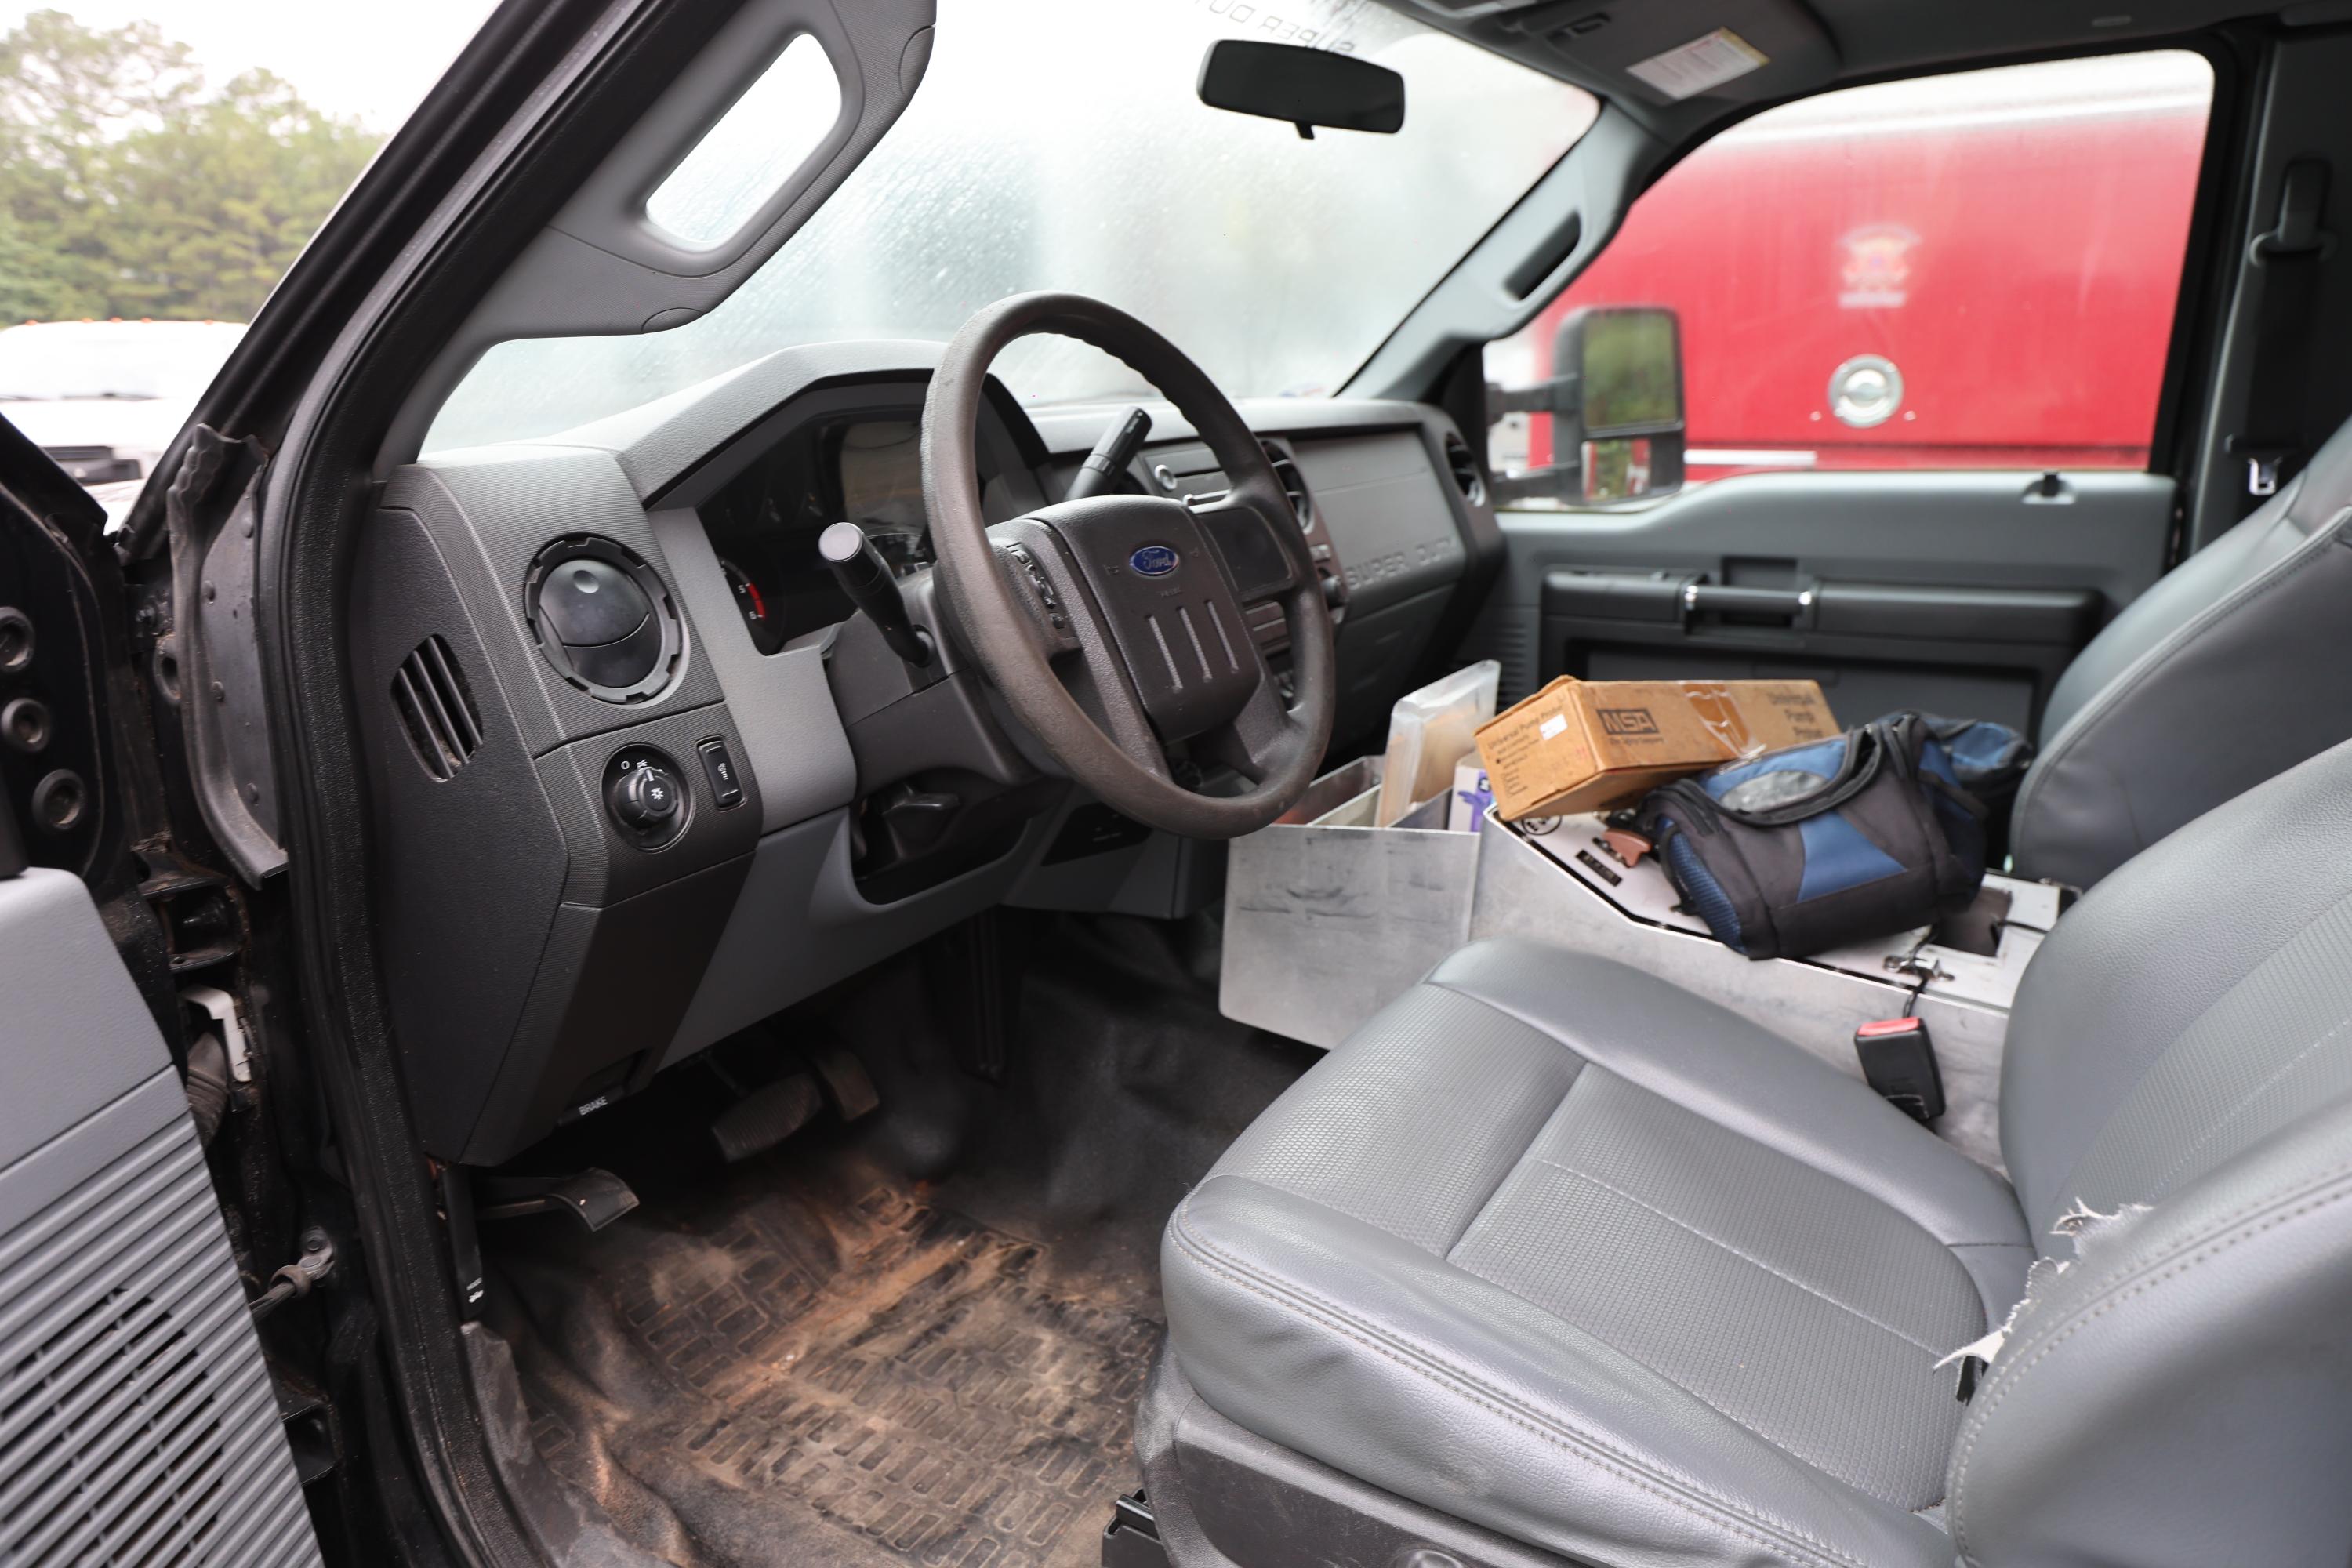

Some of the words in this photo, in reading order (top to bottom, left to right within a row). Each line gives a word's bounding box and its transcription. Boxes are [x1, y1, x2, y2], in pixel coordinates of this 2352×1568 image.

[1138, 548, 1174, 572] Ford
[1345, 550, 1410, 590] SUPER
[738, 584, 746, 593] 5
[749, 610, 757, 619] 6
[578, 1095, 608, 1116] BRAKE
